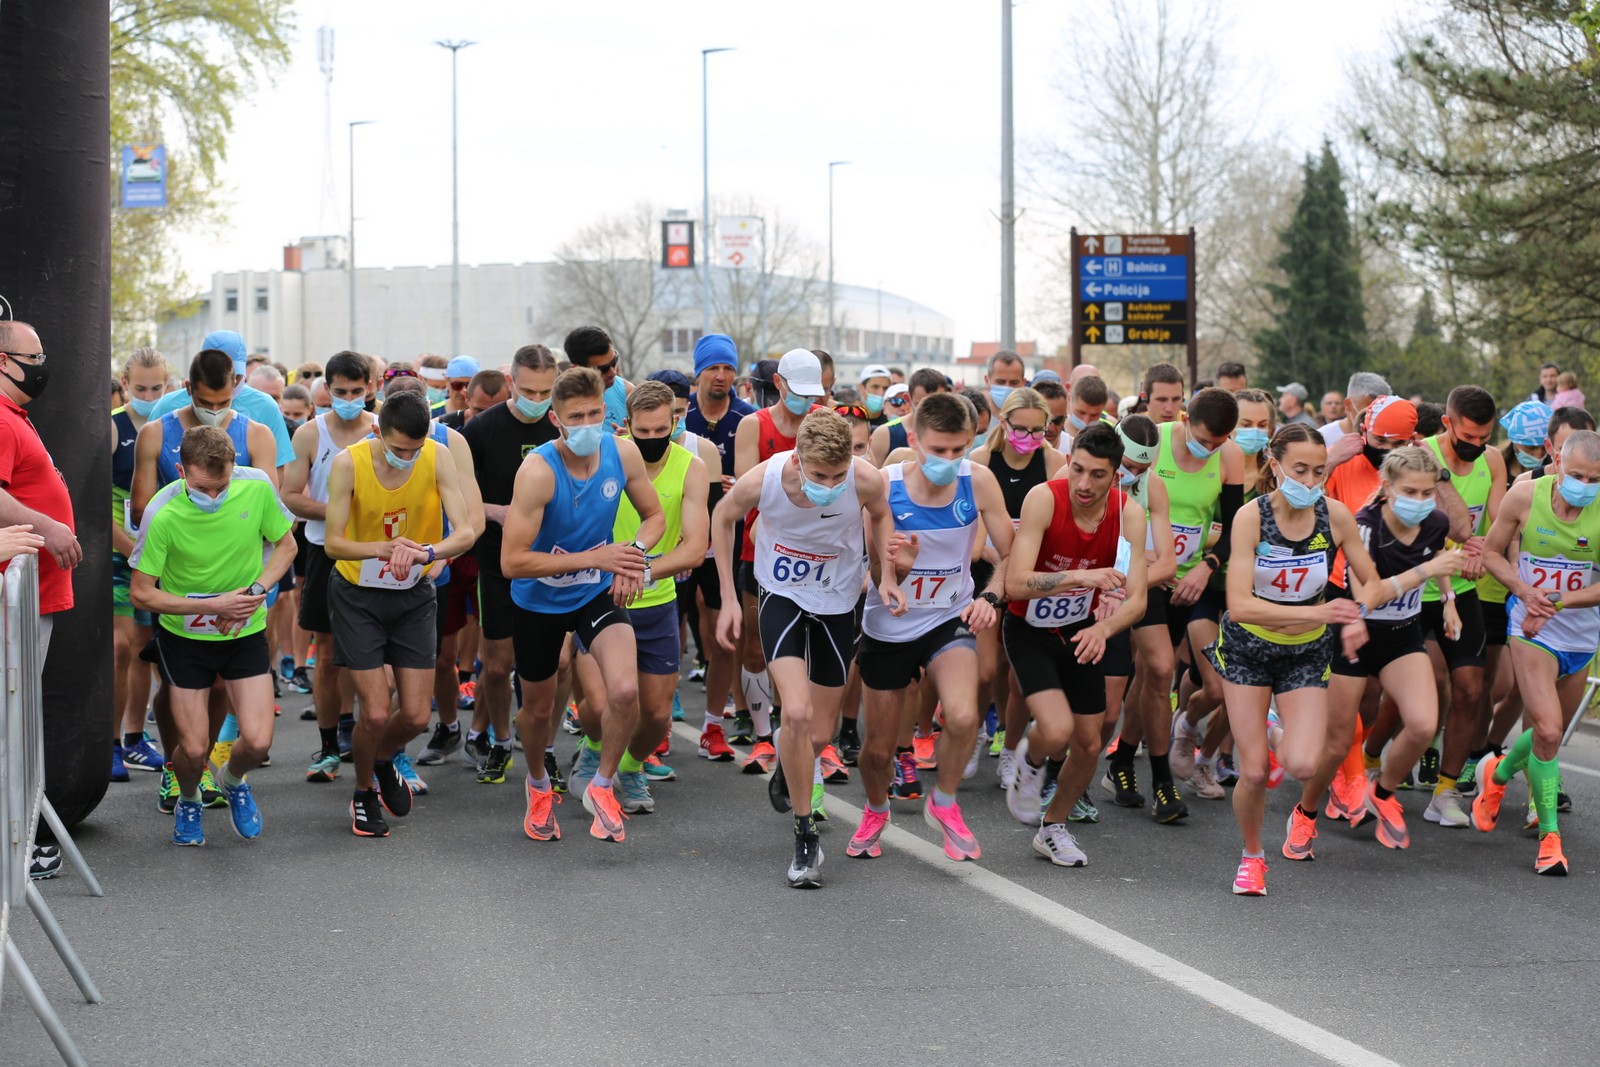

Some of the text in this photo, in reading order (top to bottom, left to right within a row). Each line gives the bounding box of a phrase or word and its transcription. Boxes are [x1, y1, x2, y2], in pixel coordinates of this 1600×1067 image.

[1126, 262, 1167, 273] Bolnica
[1103, 283, 1150, 298] Policija
[1128, 328, 1170, 341] Groblje
[773, 556, 826, 582] 691
[1271, 568, 1309, 593] 47
[1532, 567, 1583, 592] 216
[911, 576, 946, 600] 17
[1035, 596, 1087, 620] 683
